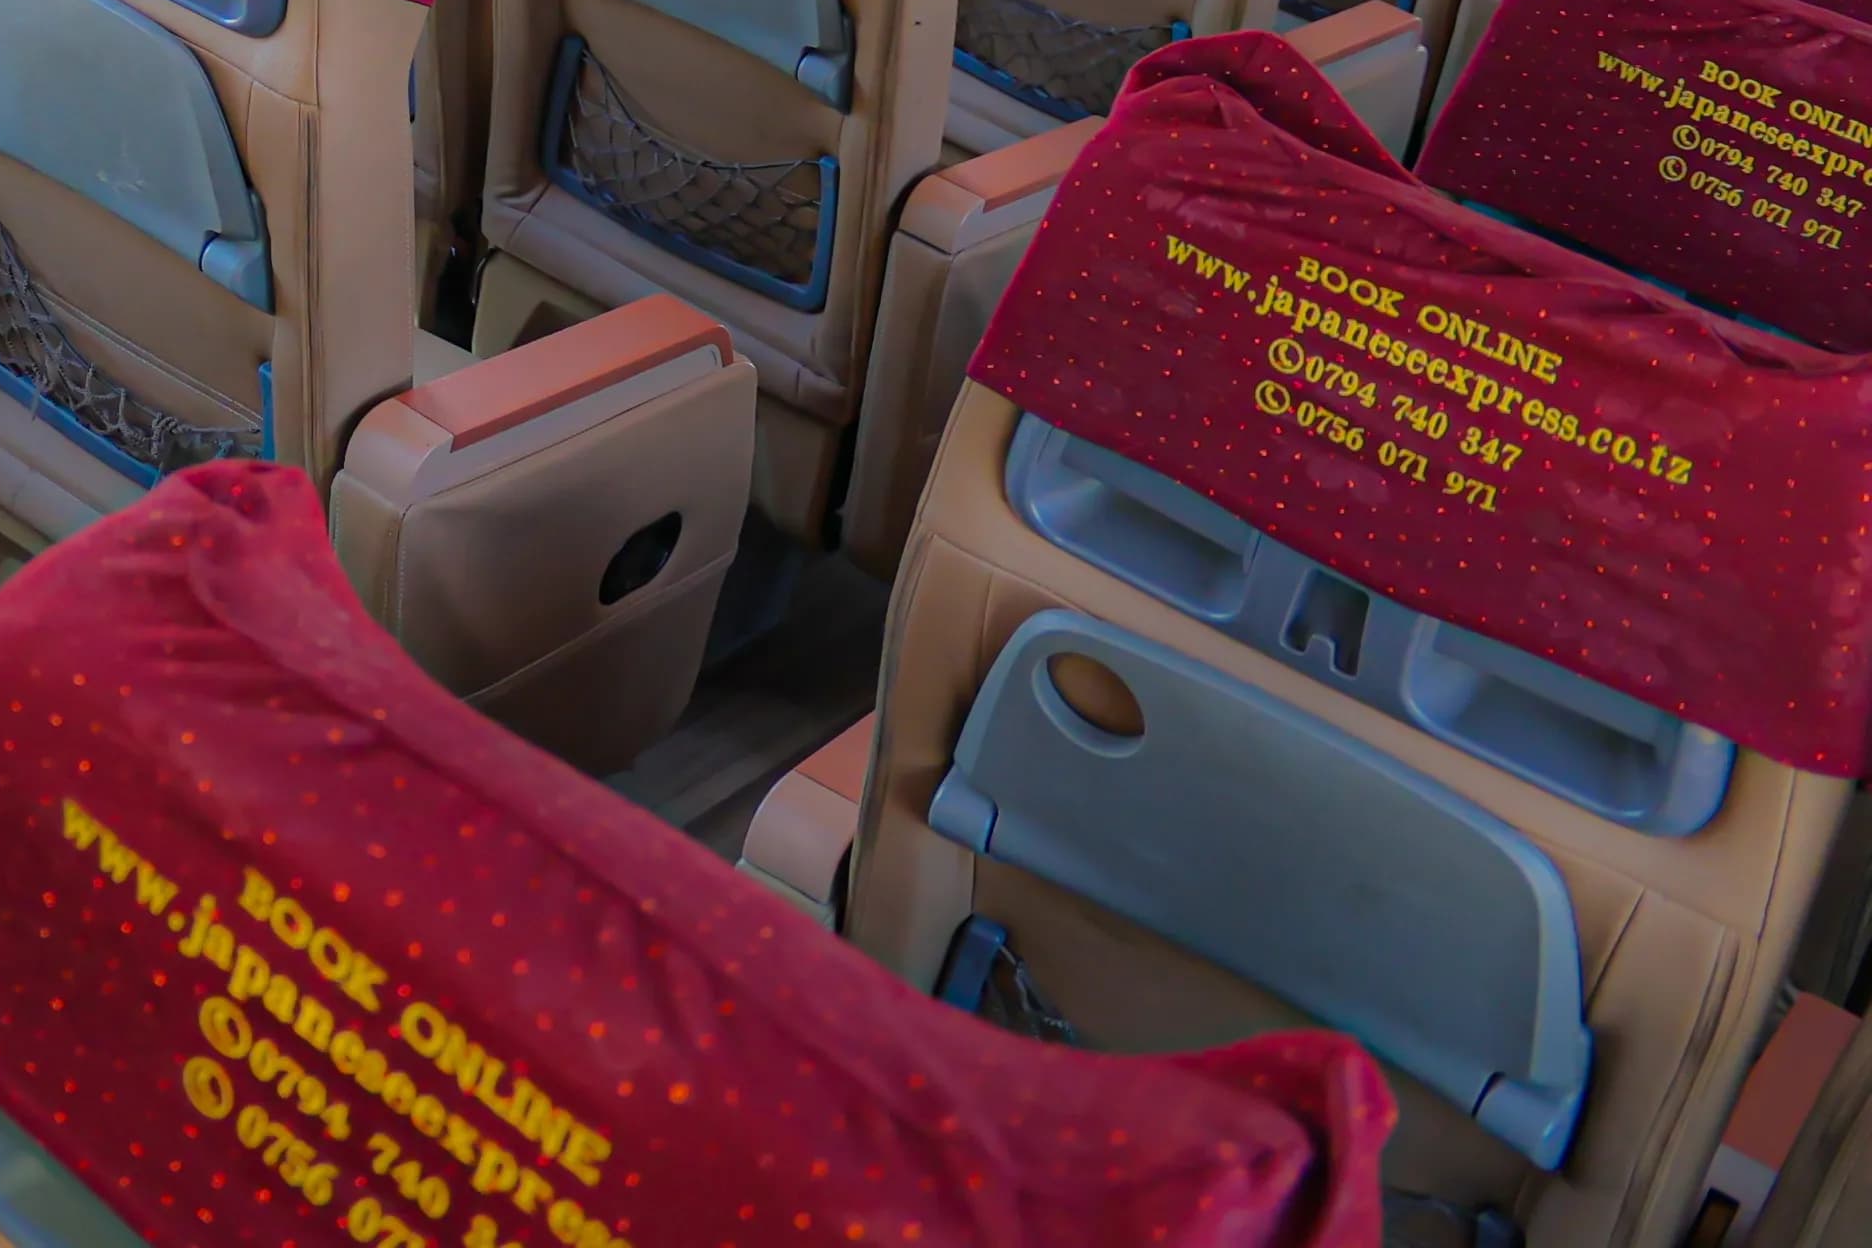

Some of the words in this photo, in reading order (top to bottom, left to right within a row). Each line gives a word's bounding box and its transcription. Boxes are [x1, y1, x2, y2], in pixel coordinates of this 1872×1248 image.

[1699, 60, 1782, 109] BOOK
[1690, 171, 1744, 208] 0756
[1752, 198, 1792, 229] 071
[1800, 219, 1843, 250] 971
[1700, 138, 1755, 174] 0794
[1767, 165, 1809, 197] 740
[1816, 187, 1864, 218] 347
[1164, 234, 1695, 487] www.japaneseexpress.co.tz
[1295, 255, 1405, 319] BOOK
[1417, 304, 1563, 385] ONLINE
[1296, 399, 1366, 453] 0756
[1377, 440, 1430, 485] 071
[1441, 471, 1500, 514] 971
[1303, 354, 1378, 410] 0794
[1391, 394, 1449, 441] 740
[1460, 425, 1523, 473] 347
[238, 865, 388, 1014] BOOK
[400, 1001, 612, 1189] ONLINE
[237, 1104, 339, 1206] 0756
[249, 1038, 350, 1141] 0794
[367, 1133, 450, 1219] 740
